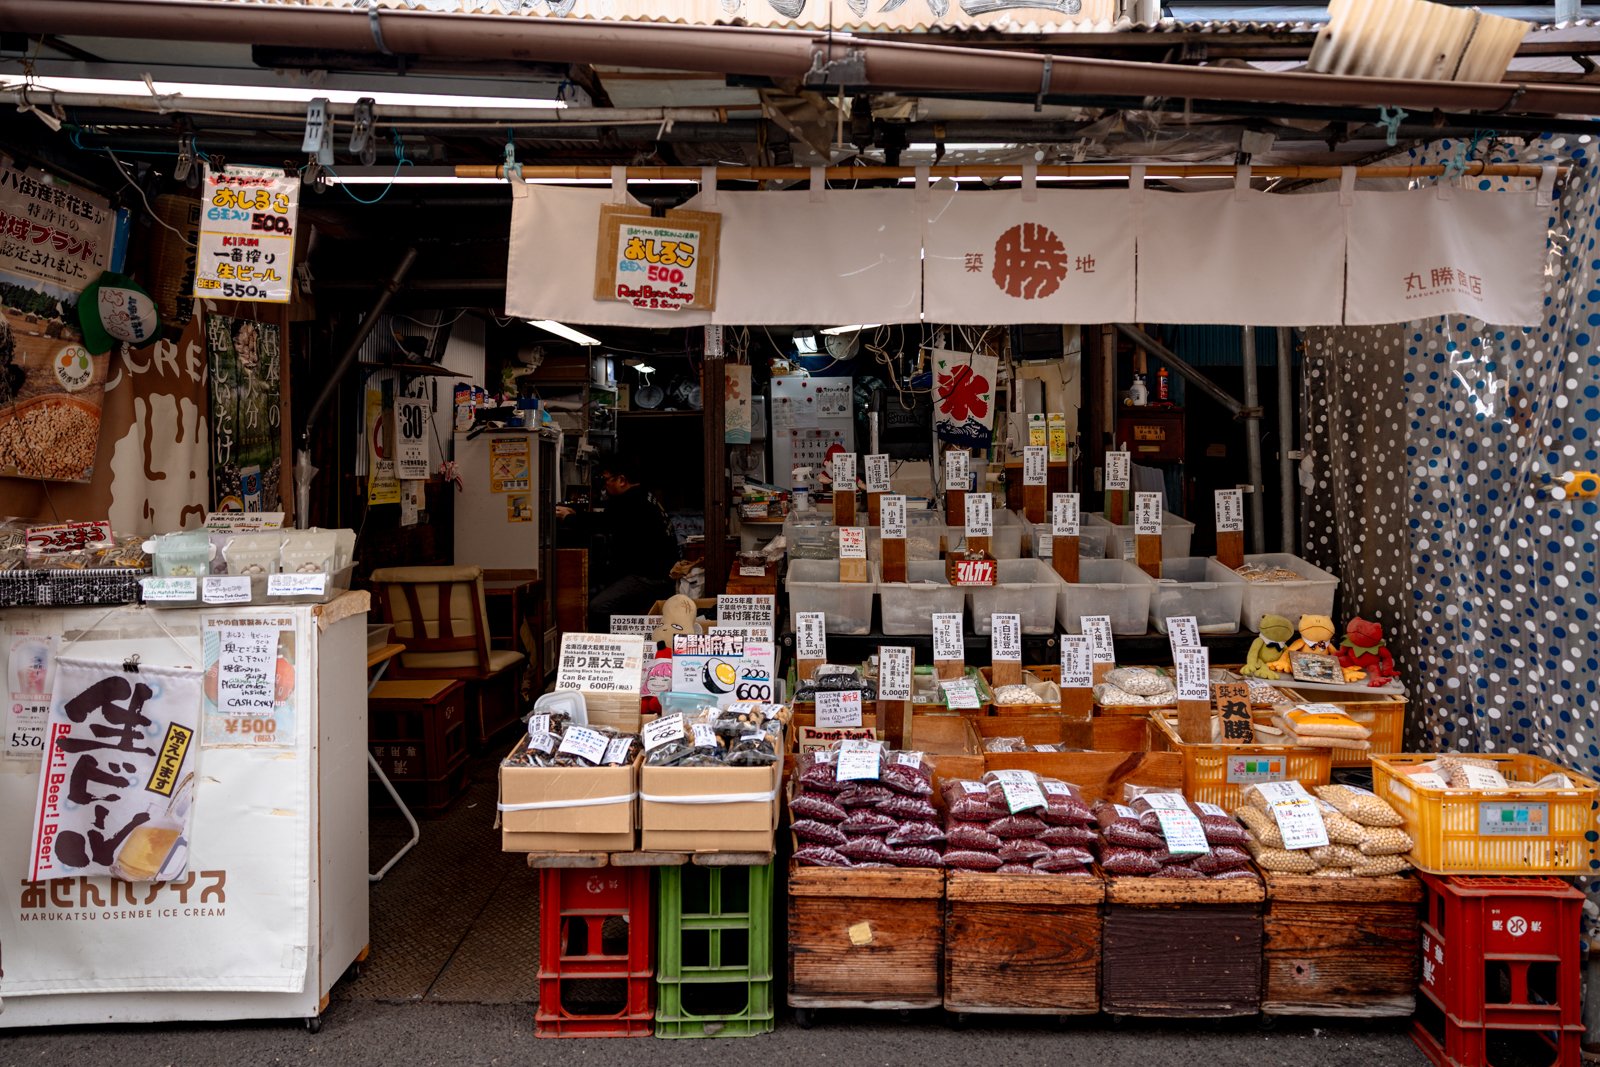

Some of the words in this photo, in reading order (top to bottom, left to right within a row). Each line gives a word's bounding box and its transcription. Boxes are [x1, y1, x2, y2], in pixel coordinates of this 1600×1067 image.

[2, 170, 104, 225] 八街産落花生が
[212, 187, 289, 214] おしるこ
[27, 202, 79, 231] 特許庁の
[207, 207, 250, 221] 白玉入り
[251, 213, 292, 236] 500円
[223, 236, 259, 246] KIRIN
[213, 248, 275, 264] 一番搾り
[624, 236, 695, 268] おしるこ
[217, 263, 281, 282] 生ビール
[965, 253, 983, 272] 築
[1075, 254, 1096, 273] 地
[197, 279, 221, 289] BEER
[647, 265, 684, 284] 500
[1404, 266, 1482, 294] 丸勝商店
[223, 283, 267, 298] 550円
[617, 284, 643, 298] Red
[643, 285, 670, 299] Bean
[669, 287, 694, 303] Soup
[209, 318, 233, 466] 乾しいたけ
[403, 405, 422, 438] 30
[874, 464, 882, 483] 白花豆
[888, 510, 896, 525] 小豆
[722, 612, 771, 621] 味付落花生
[805, 624, 813, 648] 黒大豆
[1003, 625, 1011, 649] 白花豆
[1095, 627, 1103, 649] 大福豆
[1179, 628, 1188, 646] とら
[563, 657, 624, 669] 煎り黒大豆
[222, 680, 243, 689] Please
[736, 683, 771, 700] 600
[882, 690, 909, 698] 6,000円
[1219, 685, 1248, 698] 築地
[228, 698, 252, 707] CASH
[842, 692, 859, 702] 新豆
[225, 719, 276, 733] ¥500
[1221, 700, 1253, 744] 丸勝
[155, 727, 187, 791] 冷えてます
[55, 676, 156, 868] 生ビール
[47, 773, 66, 818] Beer!
[39, 823, 58, 870] Beer!
[20, 910, 95, 921] MARUKATSU
[103, 910, 151, 920] OSENBE
[158, 909, 178, 917] ICE
[184, 908, 226, 917] CREAM
